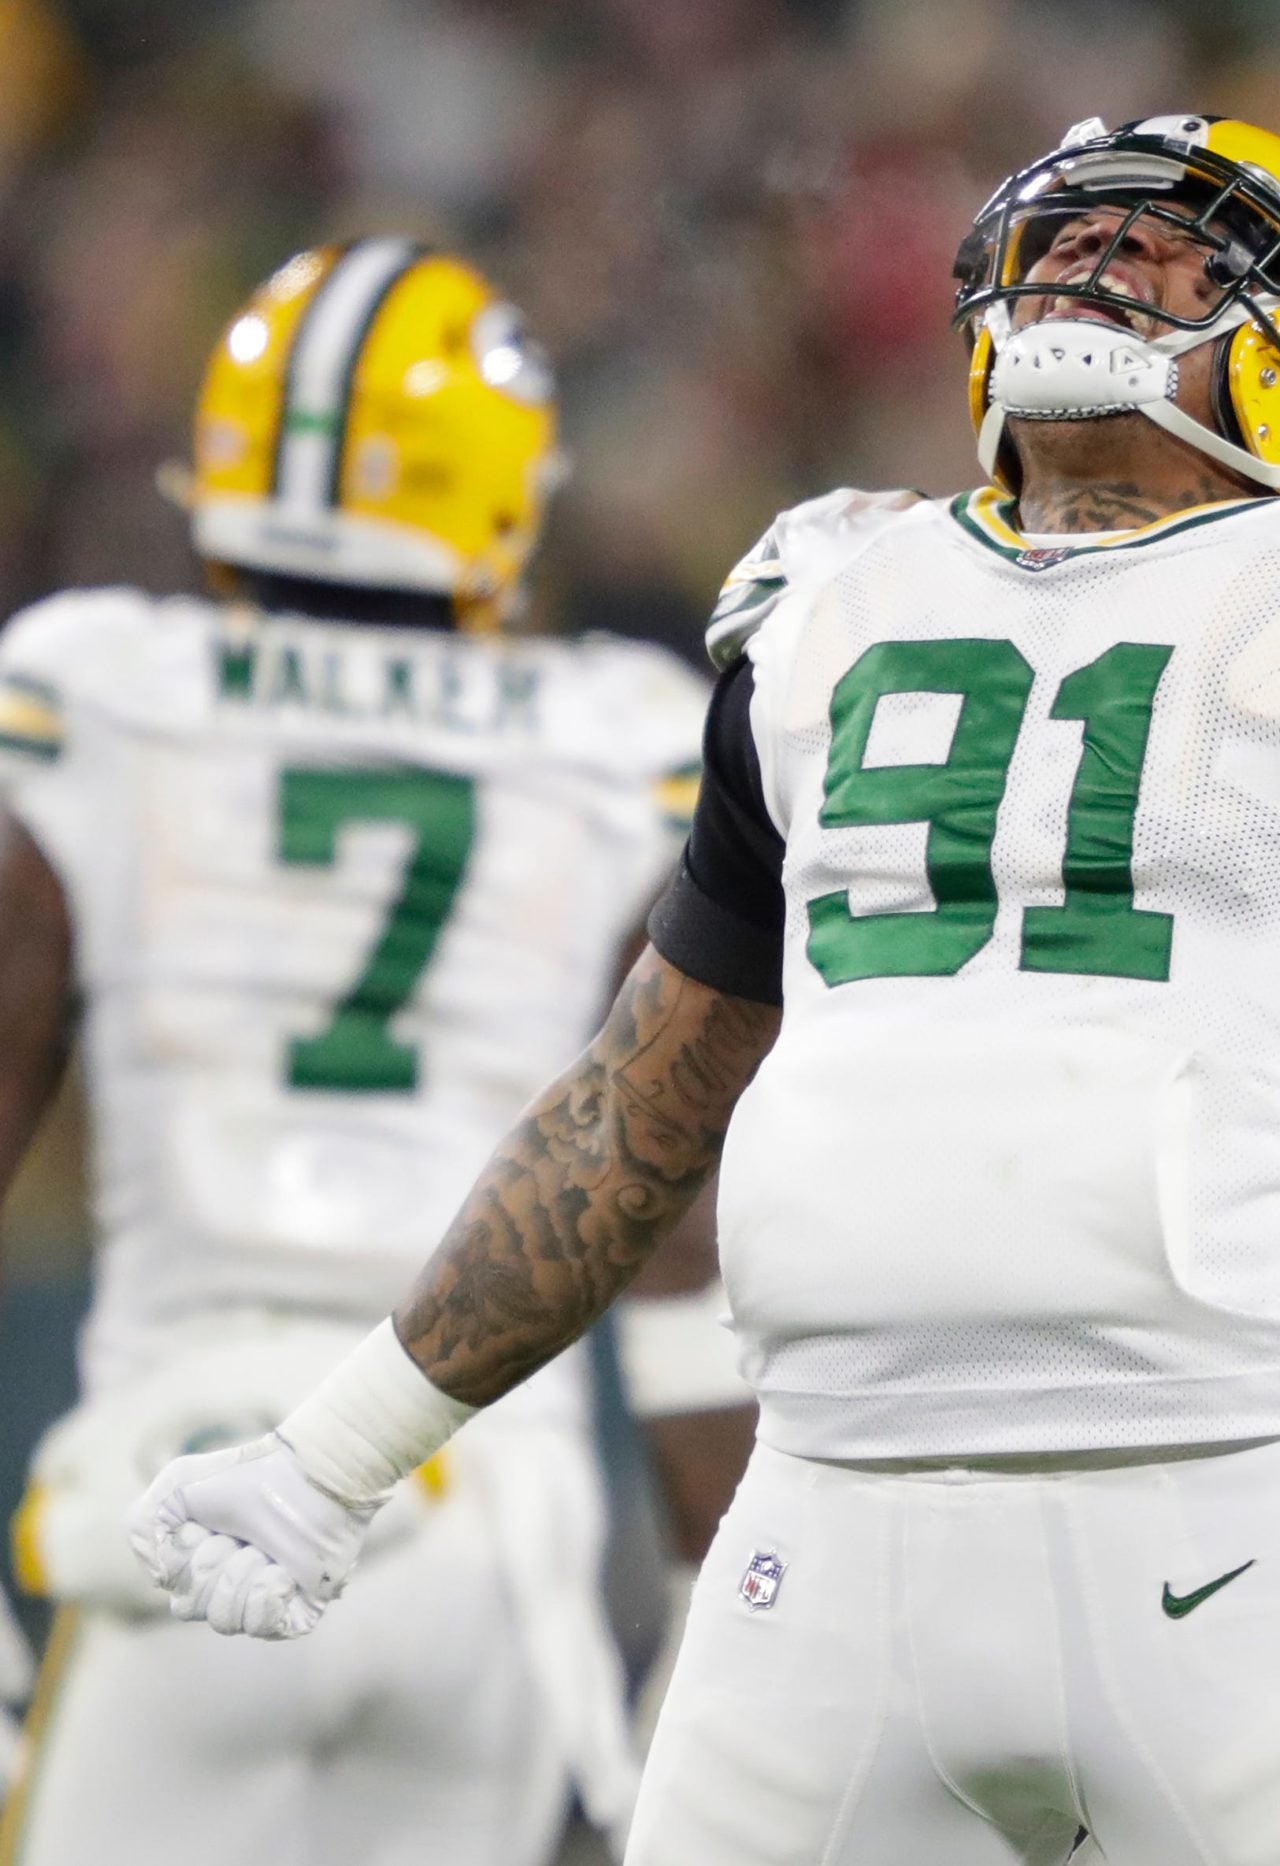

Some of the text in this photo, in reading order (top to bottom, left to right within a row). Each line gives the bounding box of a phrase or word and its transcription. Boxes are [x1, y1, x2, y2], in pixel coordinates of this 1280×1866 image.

[214, 638, 539, 731] WALKER
[806, 637, 1176, 988] 91
[278, 767, 476, 1091] 7
